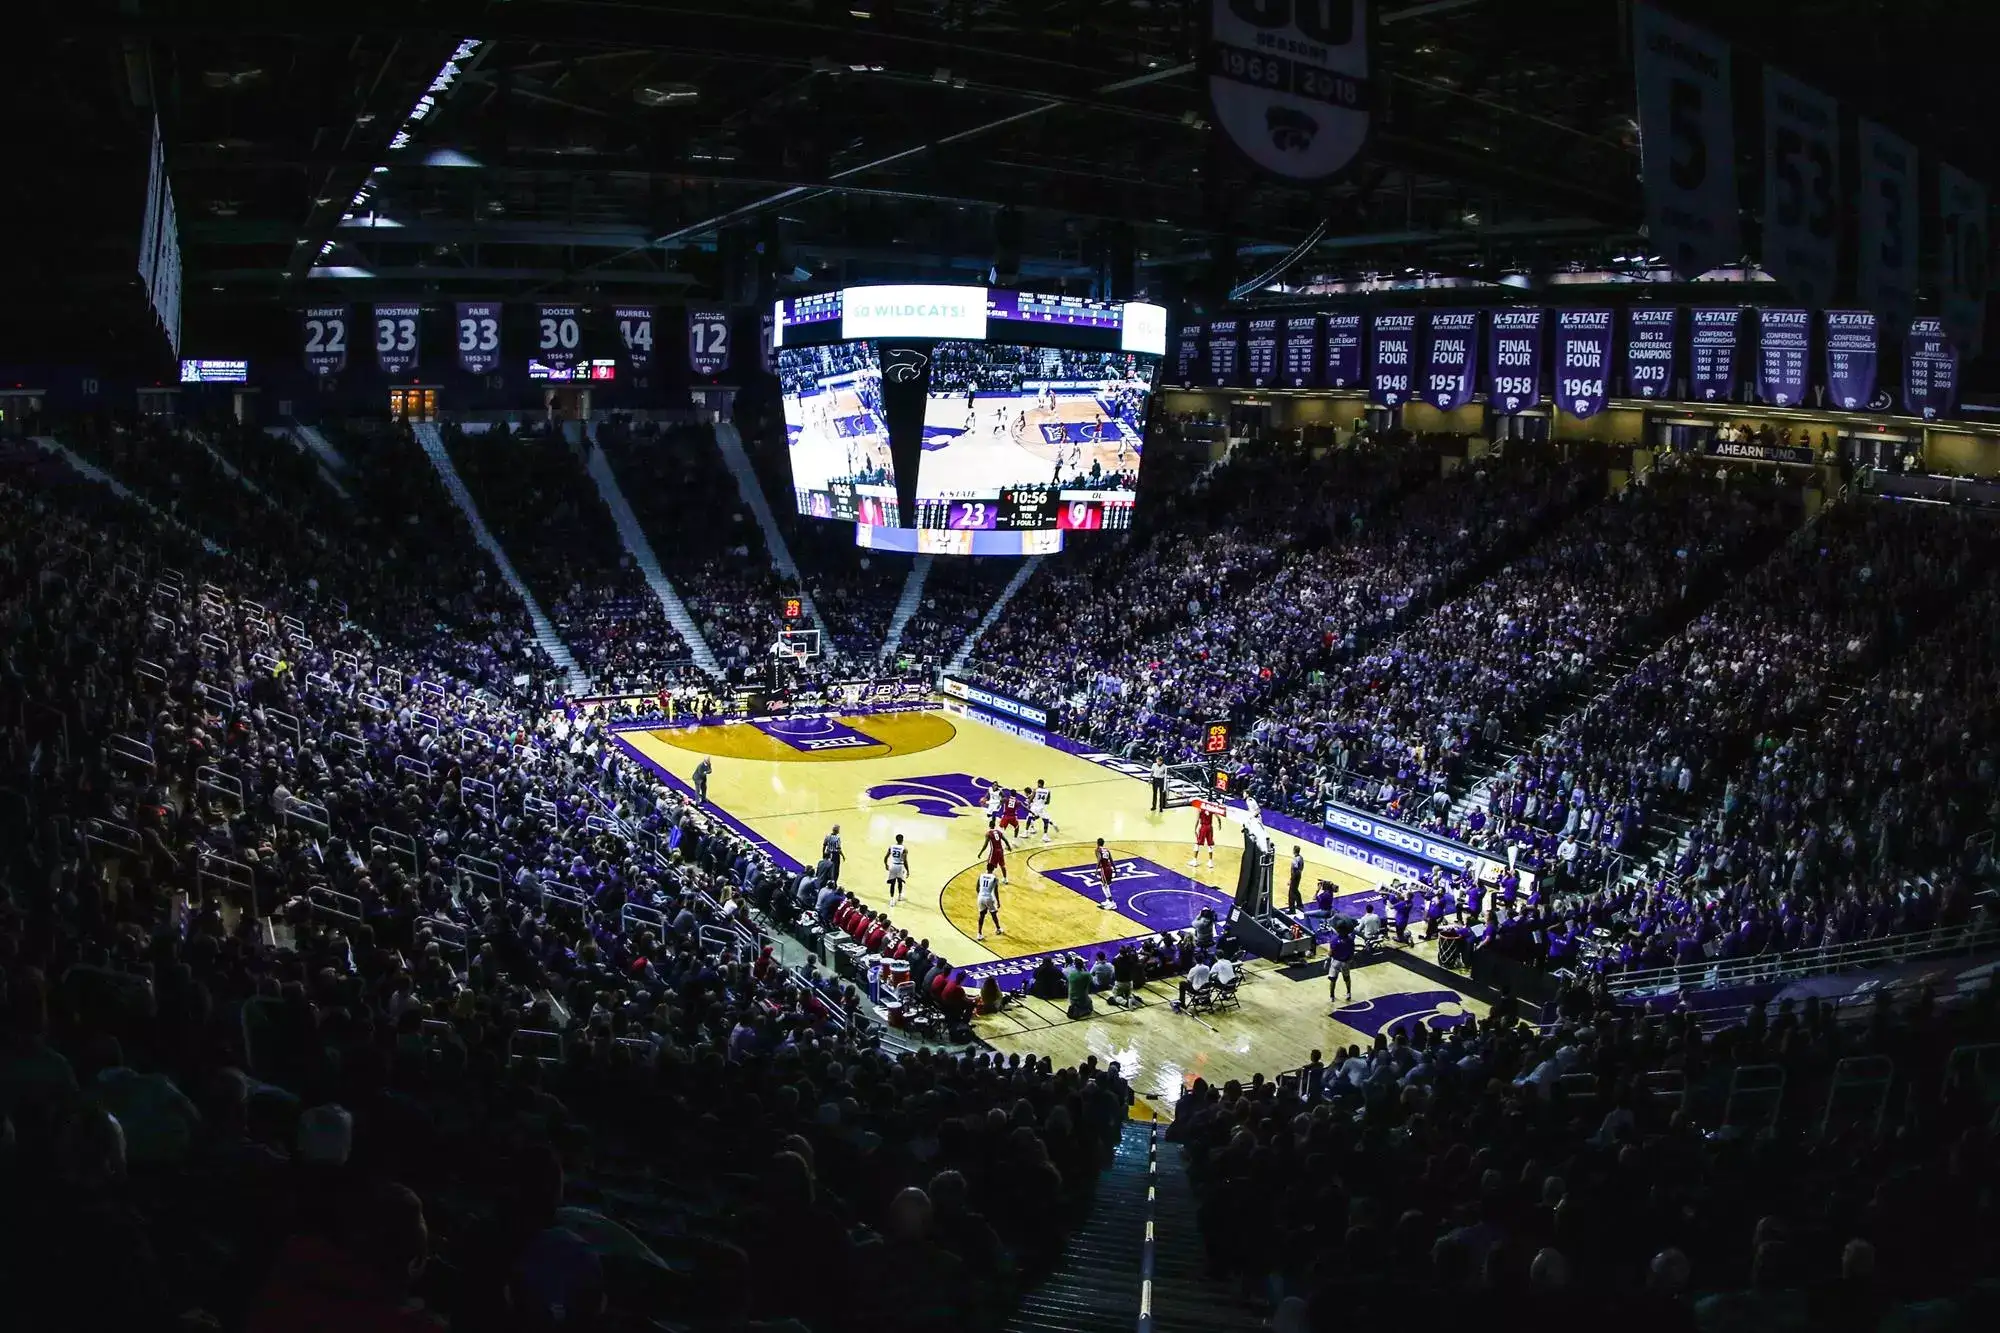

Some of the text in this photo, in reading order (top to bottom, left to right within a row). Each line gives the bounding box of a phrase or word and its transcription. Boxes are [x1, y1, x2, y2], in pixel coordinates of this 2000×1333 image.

[1219, 48, 1357, 105] 1968 2018
[375, 308, 420, 317] KNOSTMAN
[542, 308, 575, 316] BOOZER
[874, 304, 966, 317] WILDCATS!
[1632, 311, 1674, 321] K-STATE
[1695, 311, 1739, 322] K-STATE
[1288, 318, 1316, 327] K-STATE
[1329, 316, 1360, 325] K-STATE
[1374, 315, 1415, 327] K-STATE
[1431, 314, 1476, 325] K-STATE
[1493, 313, 1540, 324] K-STATE
[1560, 312, 1609, 324] K-STATE
[1761, 313, 1808, 323] K-STATE
[1828, 314, 1875, 325] K-STATE
[304, 319, 346, 352] 22
[376, 319, 417, 352] 33
[458, 318, 499, 351] 33
[539, 318, 580, 349] 30
[618, 320, 653, 352] 14
[691, 322, 727, 354] 12
[1640, 332, 1664, 340] BIG 12
[1379, 340, 1408, 352] FINAL
[1434, 339, 1466, 352] FINAL
[1498, 340, 1532, 353] FINAL
[1566, 340, 1602, 354] FINAL
[1629, 341, 1672, 349] CONFERENCE
[1924, 342, 1940, 352] NIT
[1379, 353, 1408, 364] FOUR
[1432, 352, 1464, 364] FOUR
[1498, 353, 1531, 366] FOUR
[1566, 354, 1601, 367] FOUR
[1628, 350, 1672, 359] CHAMPIONS
[1634, 366, 1665, 380] 2013
[1376, 374, 1408, 391] 1948
[1429, 374, 1465, 391] 1951
[1495, 377, 1532, 394] 1958
[1563, 378, 1603, 397] 1964
[1011, 491, 1048, 505] 10:56
[959, 502, 985, 527] 23
[1072, 503, 1087, 525] 9
[786, 606, 798, 617] 23
[968, 688, 992, 705] GEICO
[993, 697, 1019, 714] GEICO
[1020, 706, 1047, 724] GEICO
[968, 708, 1046, 745] GEICO GEICO GEICO
[1208, 735, 1226, 751] 23
[1326, 809, 1478, 870] GEICO GEICO GEICO
[892, 850, 901, 858] 23
[1324, 837, 1420, 880] GEICO GEICO
